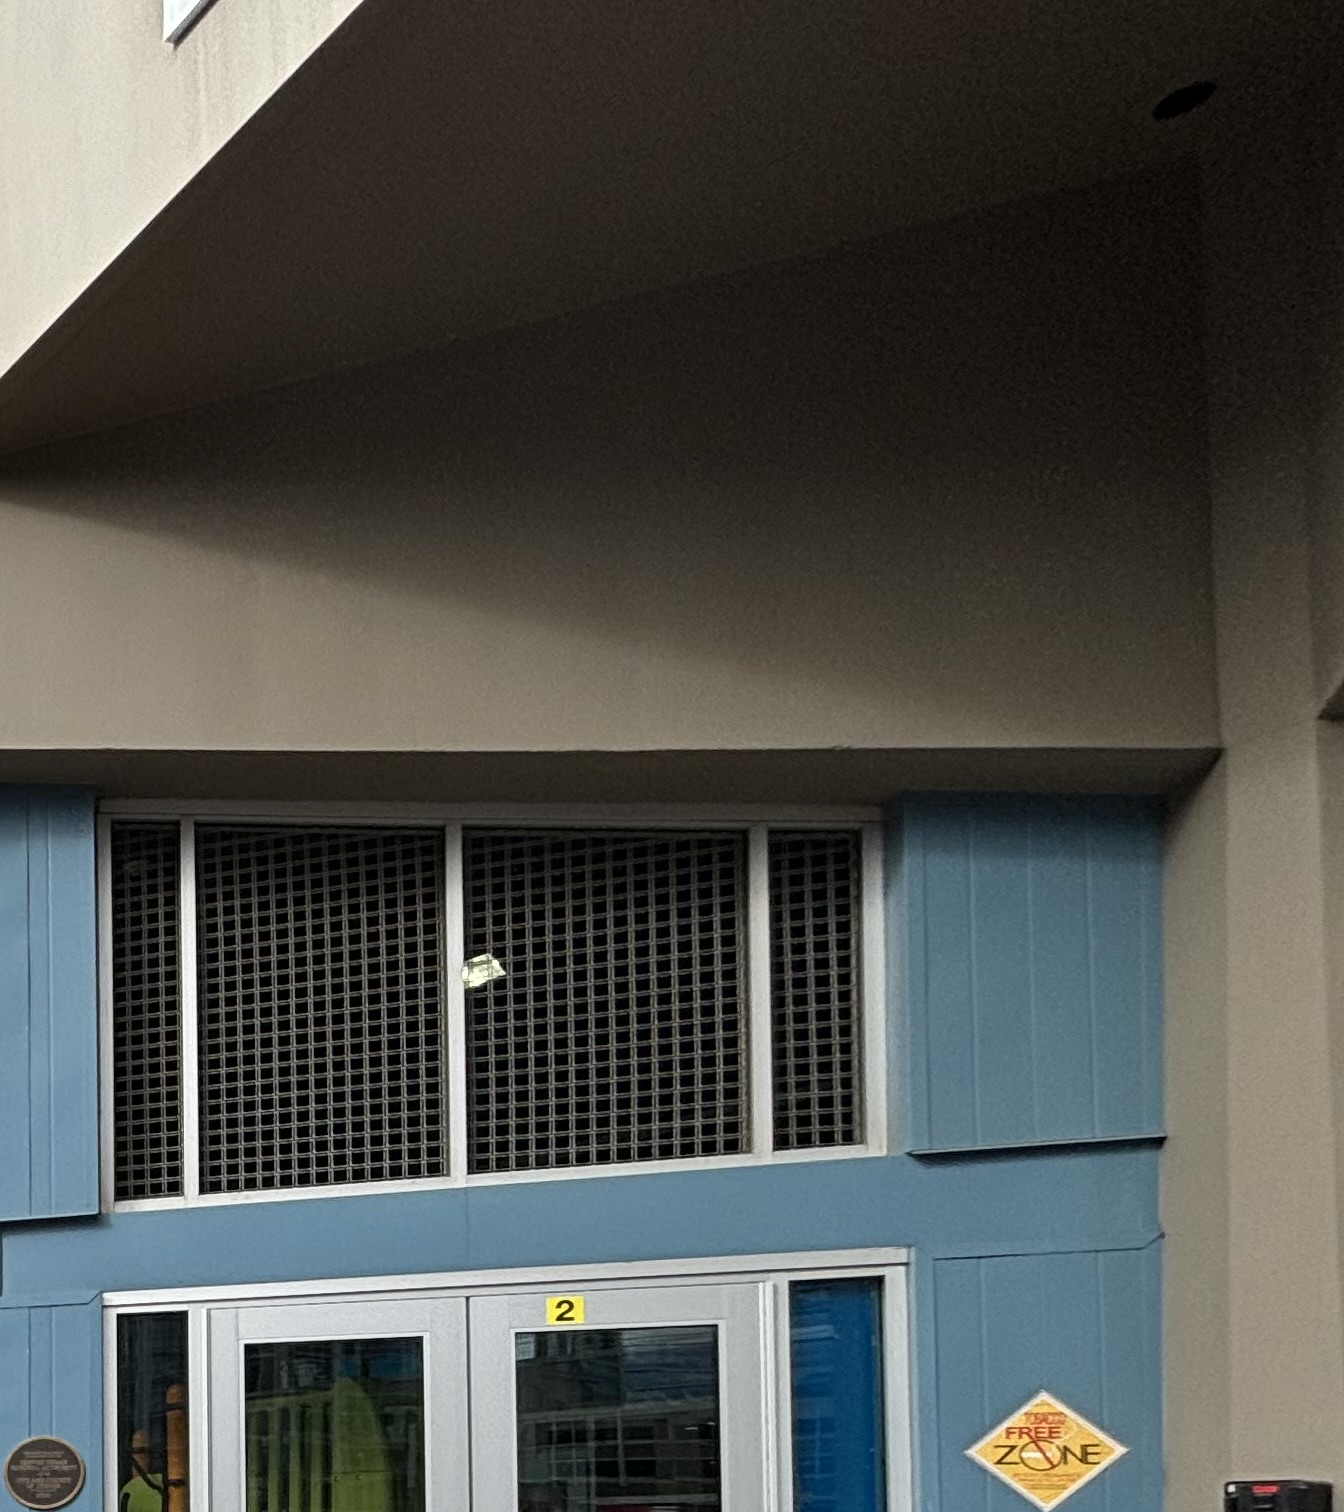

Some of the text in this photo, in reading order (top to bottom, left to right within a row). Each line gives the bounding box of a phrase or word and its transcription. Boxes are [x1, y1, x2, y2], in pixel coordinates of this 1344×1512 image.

[554, 1299, 576, 1321] 2
[1004, 1426, 1063, 1440] FREE
[993, 1440, 1101, 1471] ZONE
